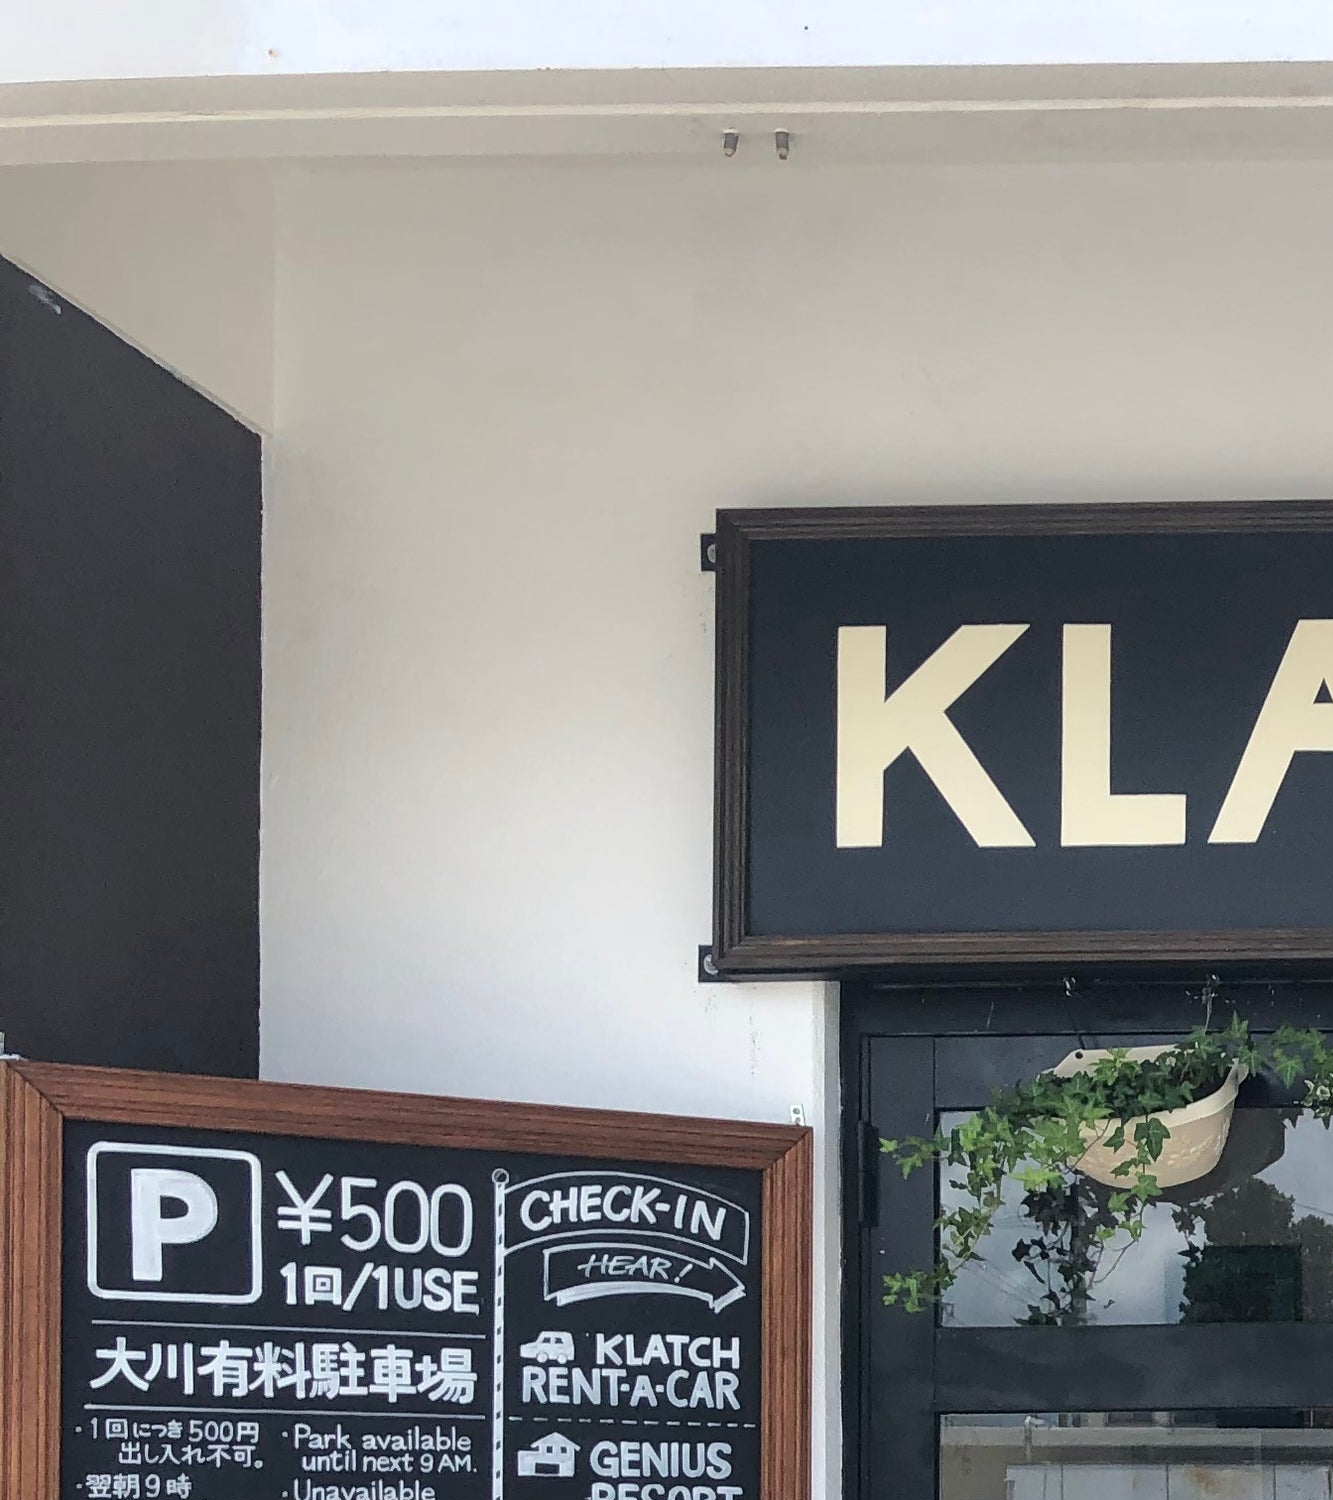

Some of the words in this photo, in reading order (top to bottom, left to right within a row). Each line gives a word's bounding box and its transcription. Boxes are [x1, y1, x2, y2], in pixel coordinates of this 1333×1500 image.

[130, 1168, 219, 1282] P
[276, 1170, 474, 1257] ¥500
[520, 1184, 727, 1241] CHECK-IN
[577, 1254, 694, 1284] HEAR!
[89, 1336, 478, 1404] 大川有料駐車場
[596, 1334, 741, 1370] KLATCH
[522, 1366, 741, 1410] RENT-A-CAR
[293, 1423, 351, 1450] Park
[362, 1425, 472, 1451] available
[302, 1449, 357, 1472] until
[362, 1453, 414, 1472] next
[588, 1442, 733, 1480] GENIUS
